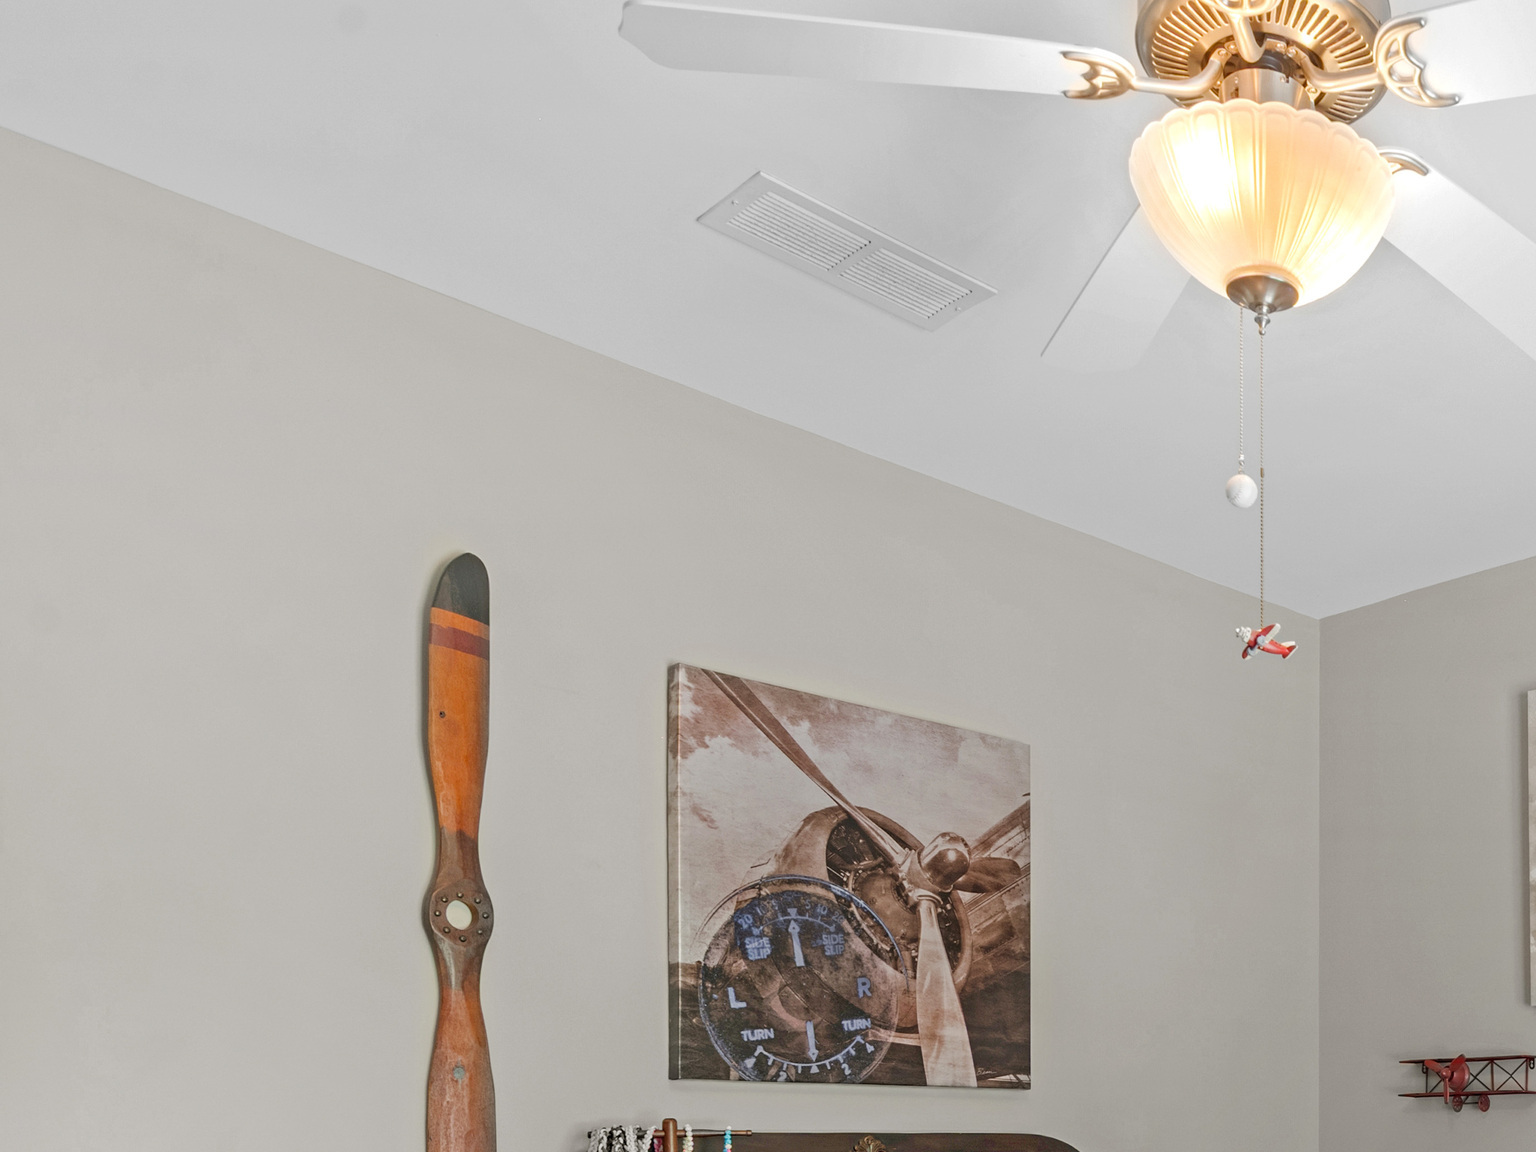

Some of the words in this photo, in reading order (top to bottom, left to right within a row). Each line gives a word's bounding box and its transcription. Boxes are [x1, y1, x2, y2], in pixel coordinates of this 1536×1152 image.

[822, 934, 845, 945] SIDE
[747, 948, 772, 961] SLIP
[824, 944, 845, 956] SLIP
[856, 977, 872, 999] R
[727, 986, 747, 1009] L
[841, 1018, 872, 1032] TURN
[740, 1028, 775, 1042] TURN
